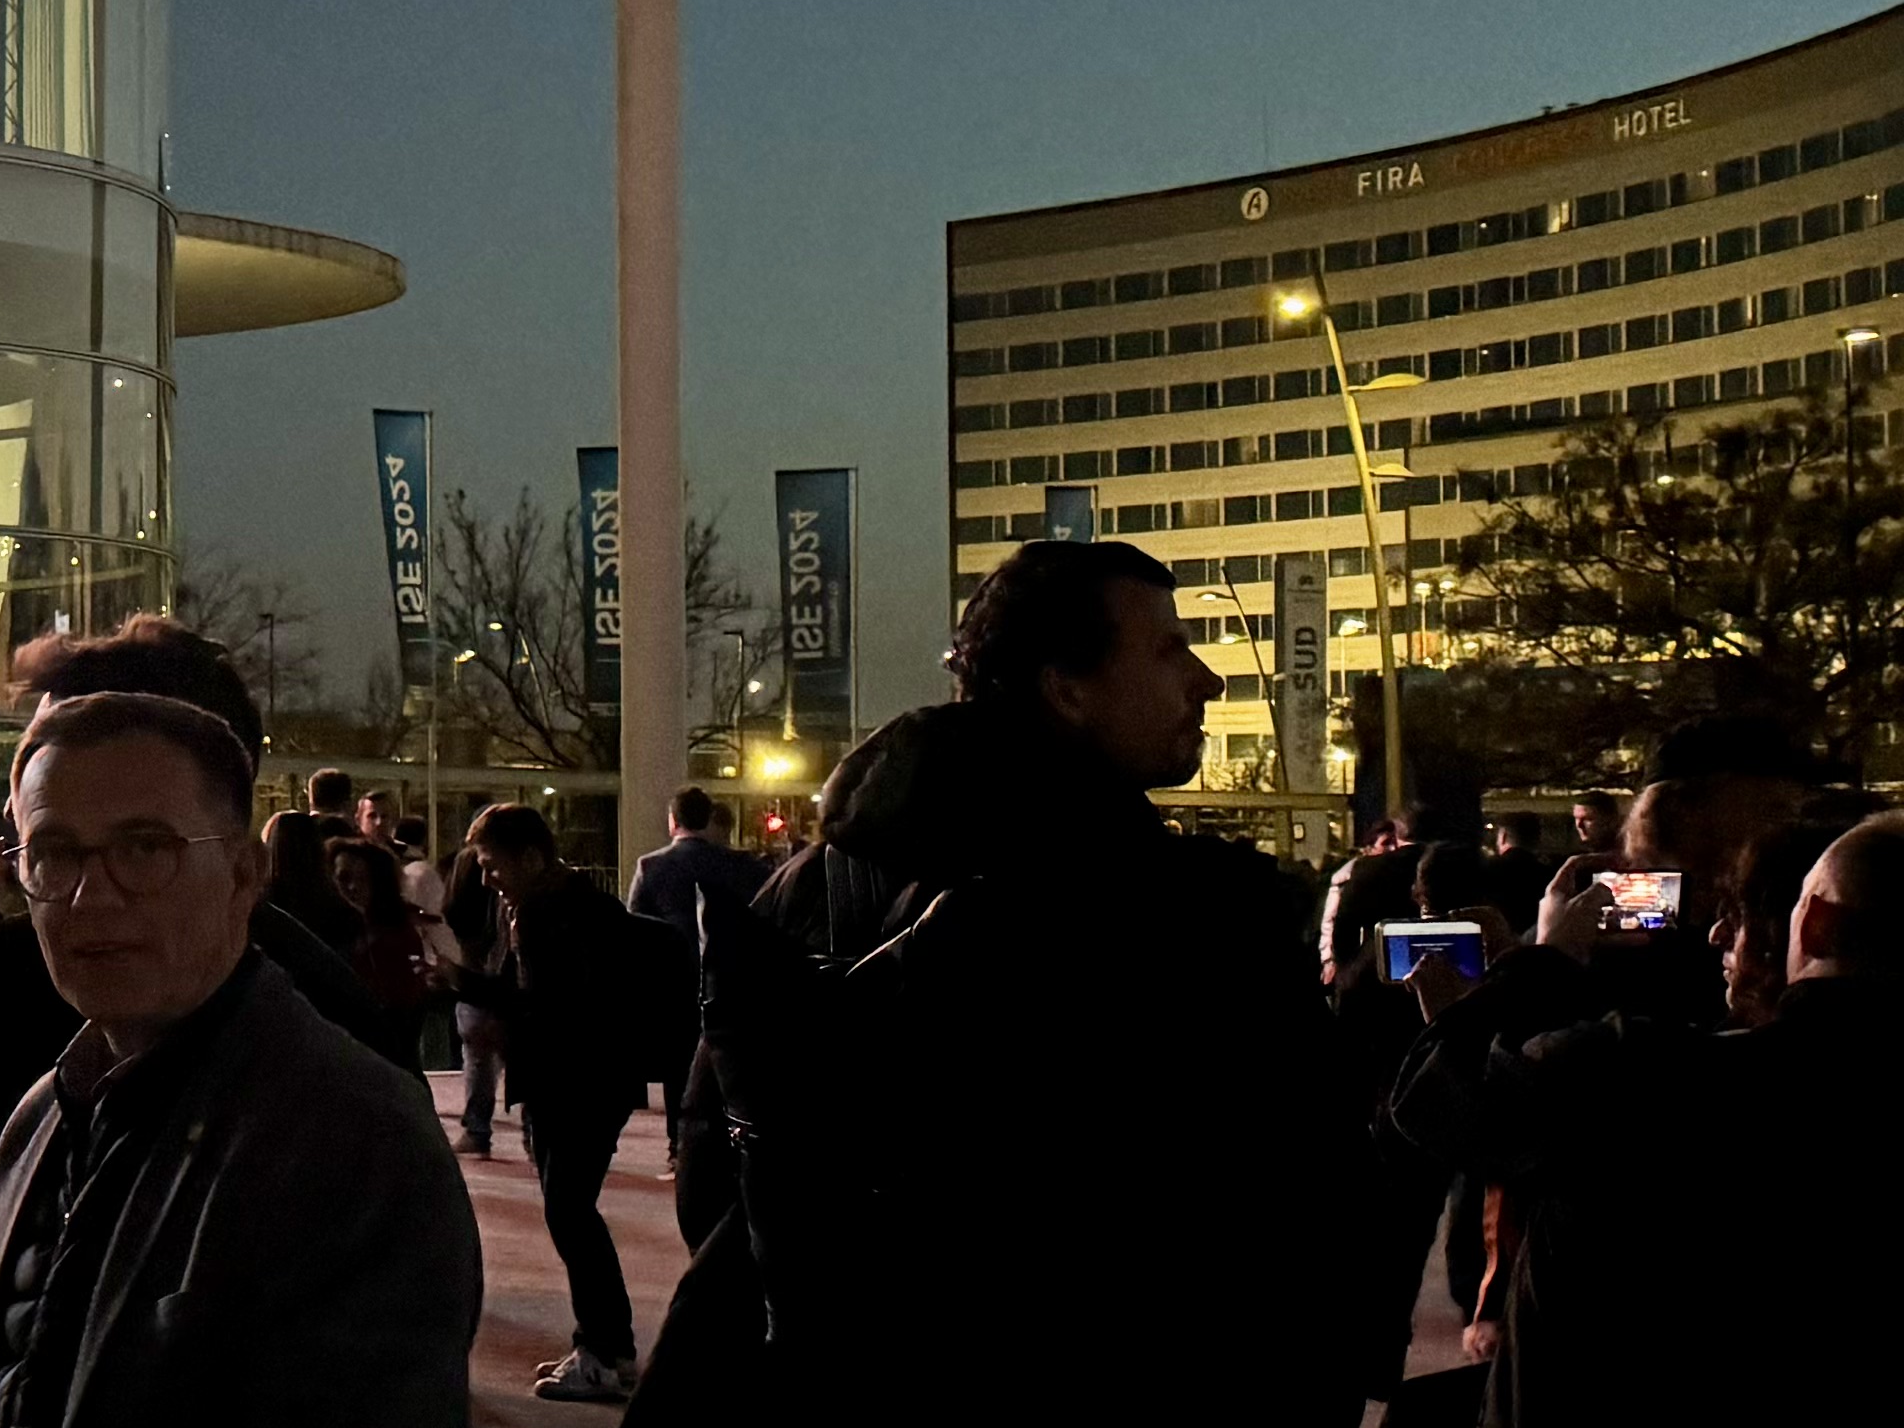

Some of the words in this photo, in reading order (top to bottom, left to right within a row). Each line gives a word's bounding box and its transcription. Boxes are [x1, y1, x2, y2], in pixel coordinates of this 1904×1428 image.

[1614, 98, 1692, 141] HOTEL
[1357, 162, 1425, 197] FIRA
[1294, 626, 1318, 691] SUD
